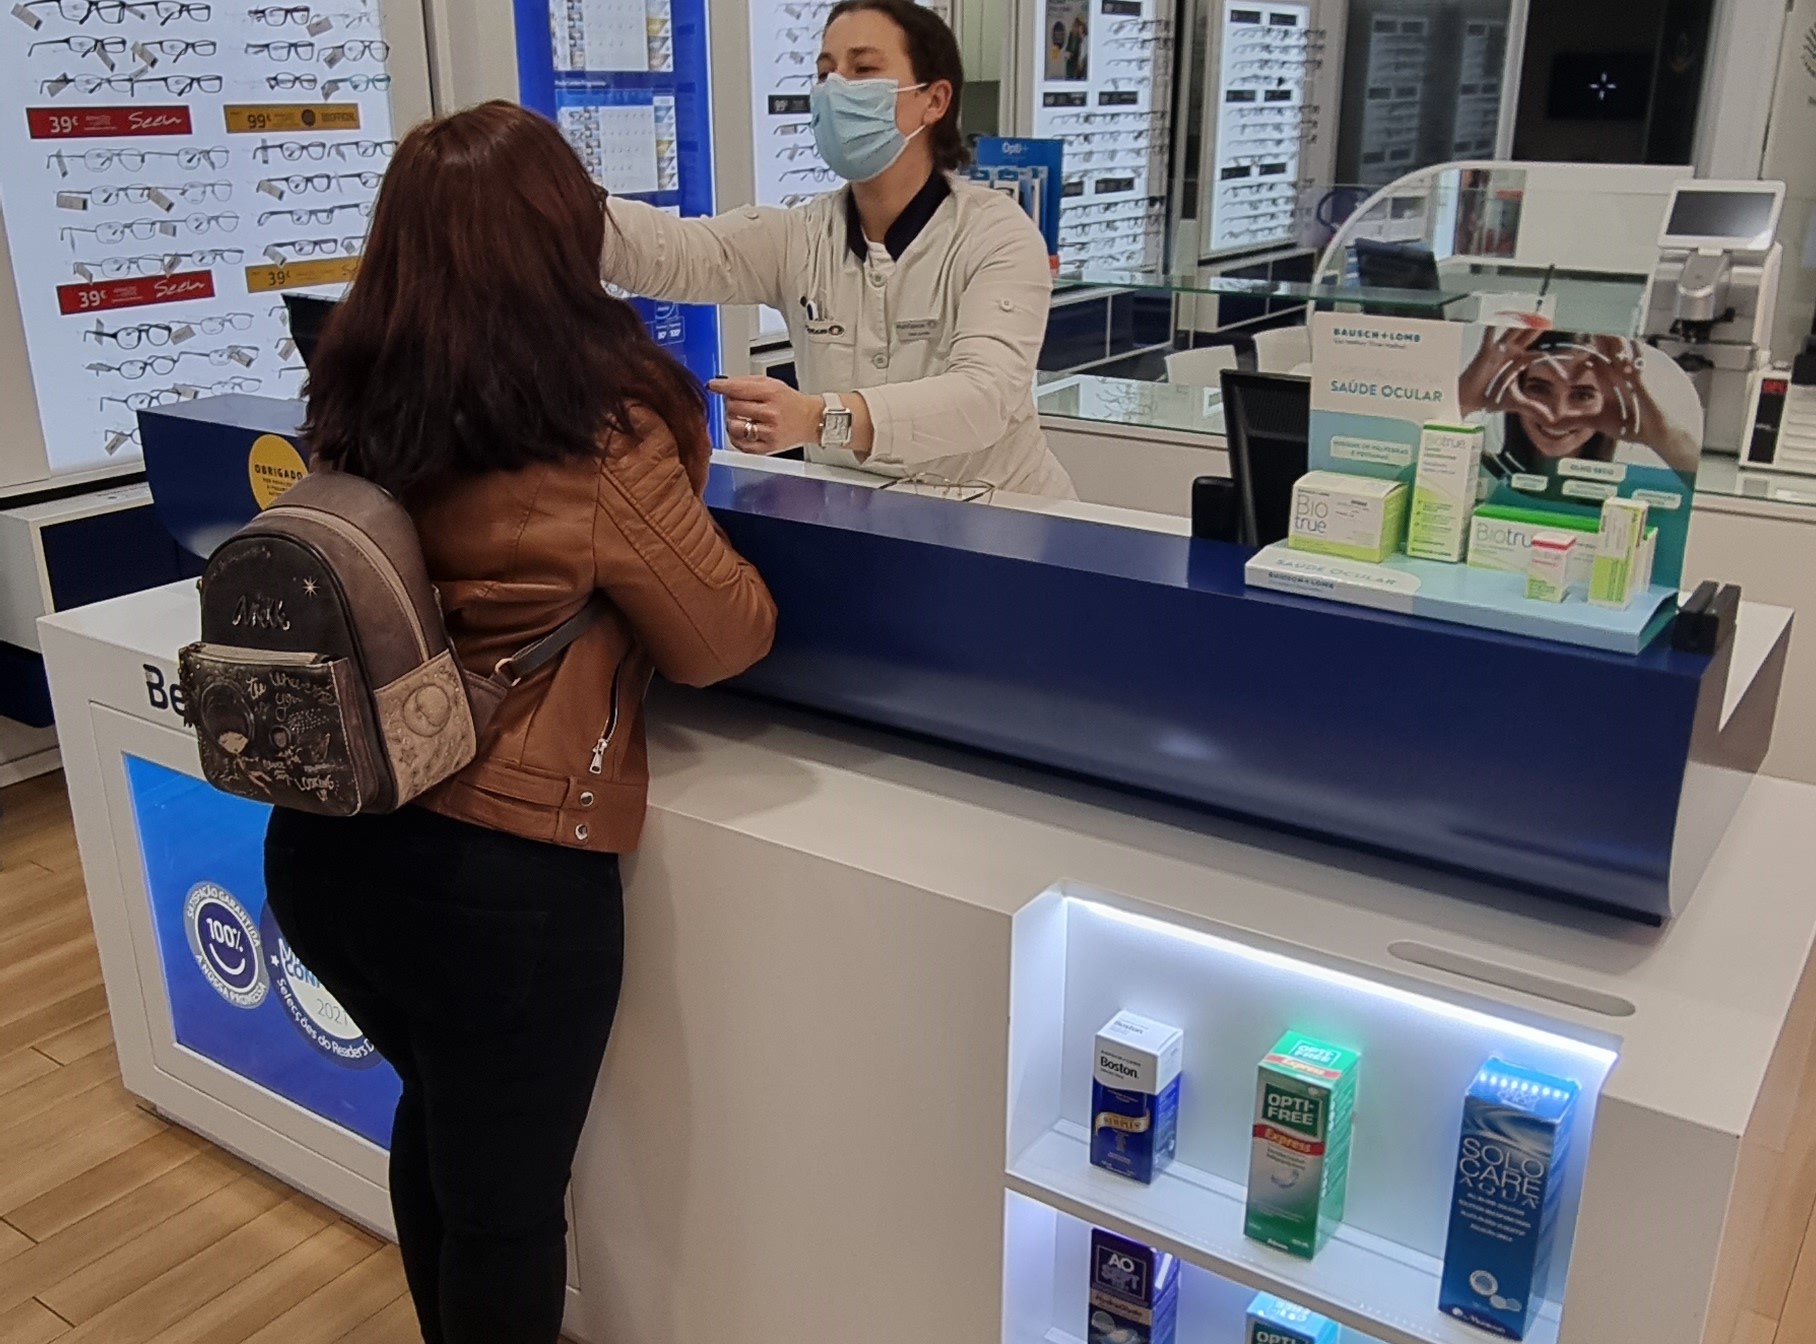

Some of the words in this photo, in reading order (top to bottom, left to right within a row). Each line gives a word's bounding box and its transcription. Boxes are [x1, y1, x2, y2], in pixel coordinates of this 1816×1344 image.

[49, 115, 79, 134] 39€
[79, 290, 107, 308] 39€
[1330, 377, 1378, 396] SAÚDE
[1381, 384, 1443, 403] OCULAR
[254, 464, 303, 481] OBRIGADO
[1294, 516, 1327, 533] true
[219, 890, 261, 948] GARANTIDA
[206, 917, 245, 953] 100%
[277, 978, 318, 1040] Selecções
[317, 1035, 332, 1051] do
[1100, 1055, 1139, 1079] Boston
[1267, 1092, 1315, 1112] OPTI-
[1266, 1105, 1315, 1126] FREE
[1264, 1127, 1312, 1154] Express
[1461, 1137, 1545, 1180] SOLO
[1459, 1157, 1542, 1200] CARE
[1108, 1253, 1135, 1273] AO
